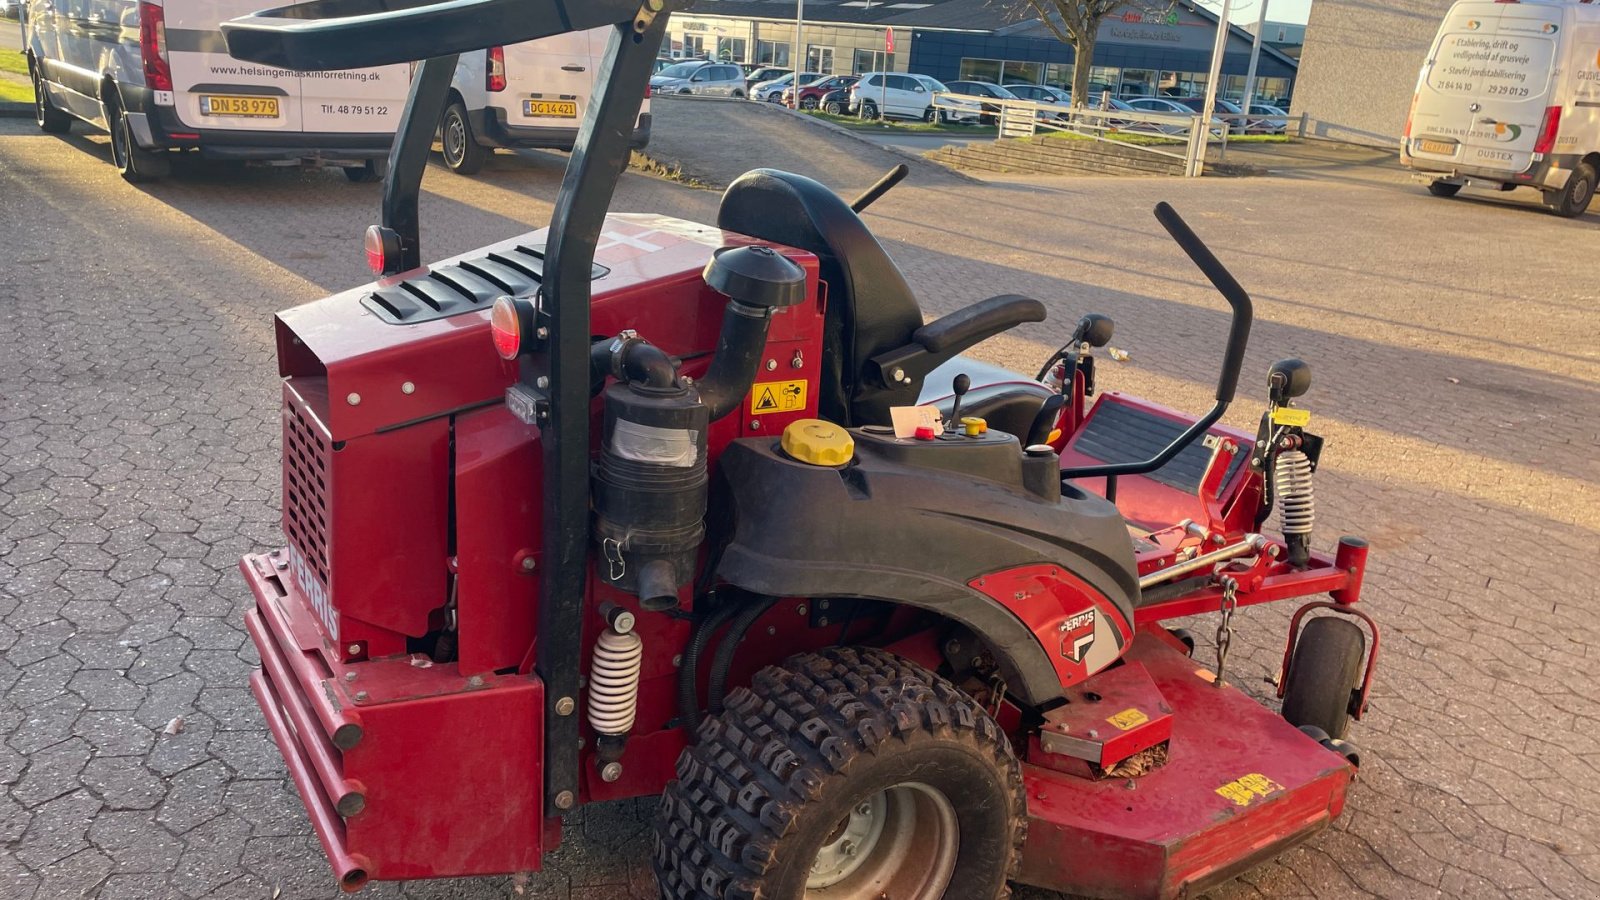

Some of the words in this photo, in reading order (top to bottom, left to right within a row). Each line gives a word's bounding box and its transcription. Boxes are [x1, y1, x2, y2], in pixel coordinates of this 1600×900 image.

[1492, 40, 1508, 49] drift
[1509, 43, 1519, 52] og
[1491, 52, 1499, 61] af
[1499, 54, 1530, 65] grusveje
[211, 98, 230, 112] DN
[233, 99, 249, 112] 58
[253, 100, 276, 114] 979
[337, 105, 350, 115] 48
[351, 106, 363, 115] 79
[364, 106, 374, 115] 51
[377, 106, 388, 115] 22
[531, 102, 544, 113] DG
[546, 103, 556, 113] 14
[558, 104, 574, 114] 421
[1477, 149, 1513, 161] DUSTEX
